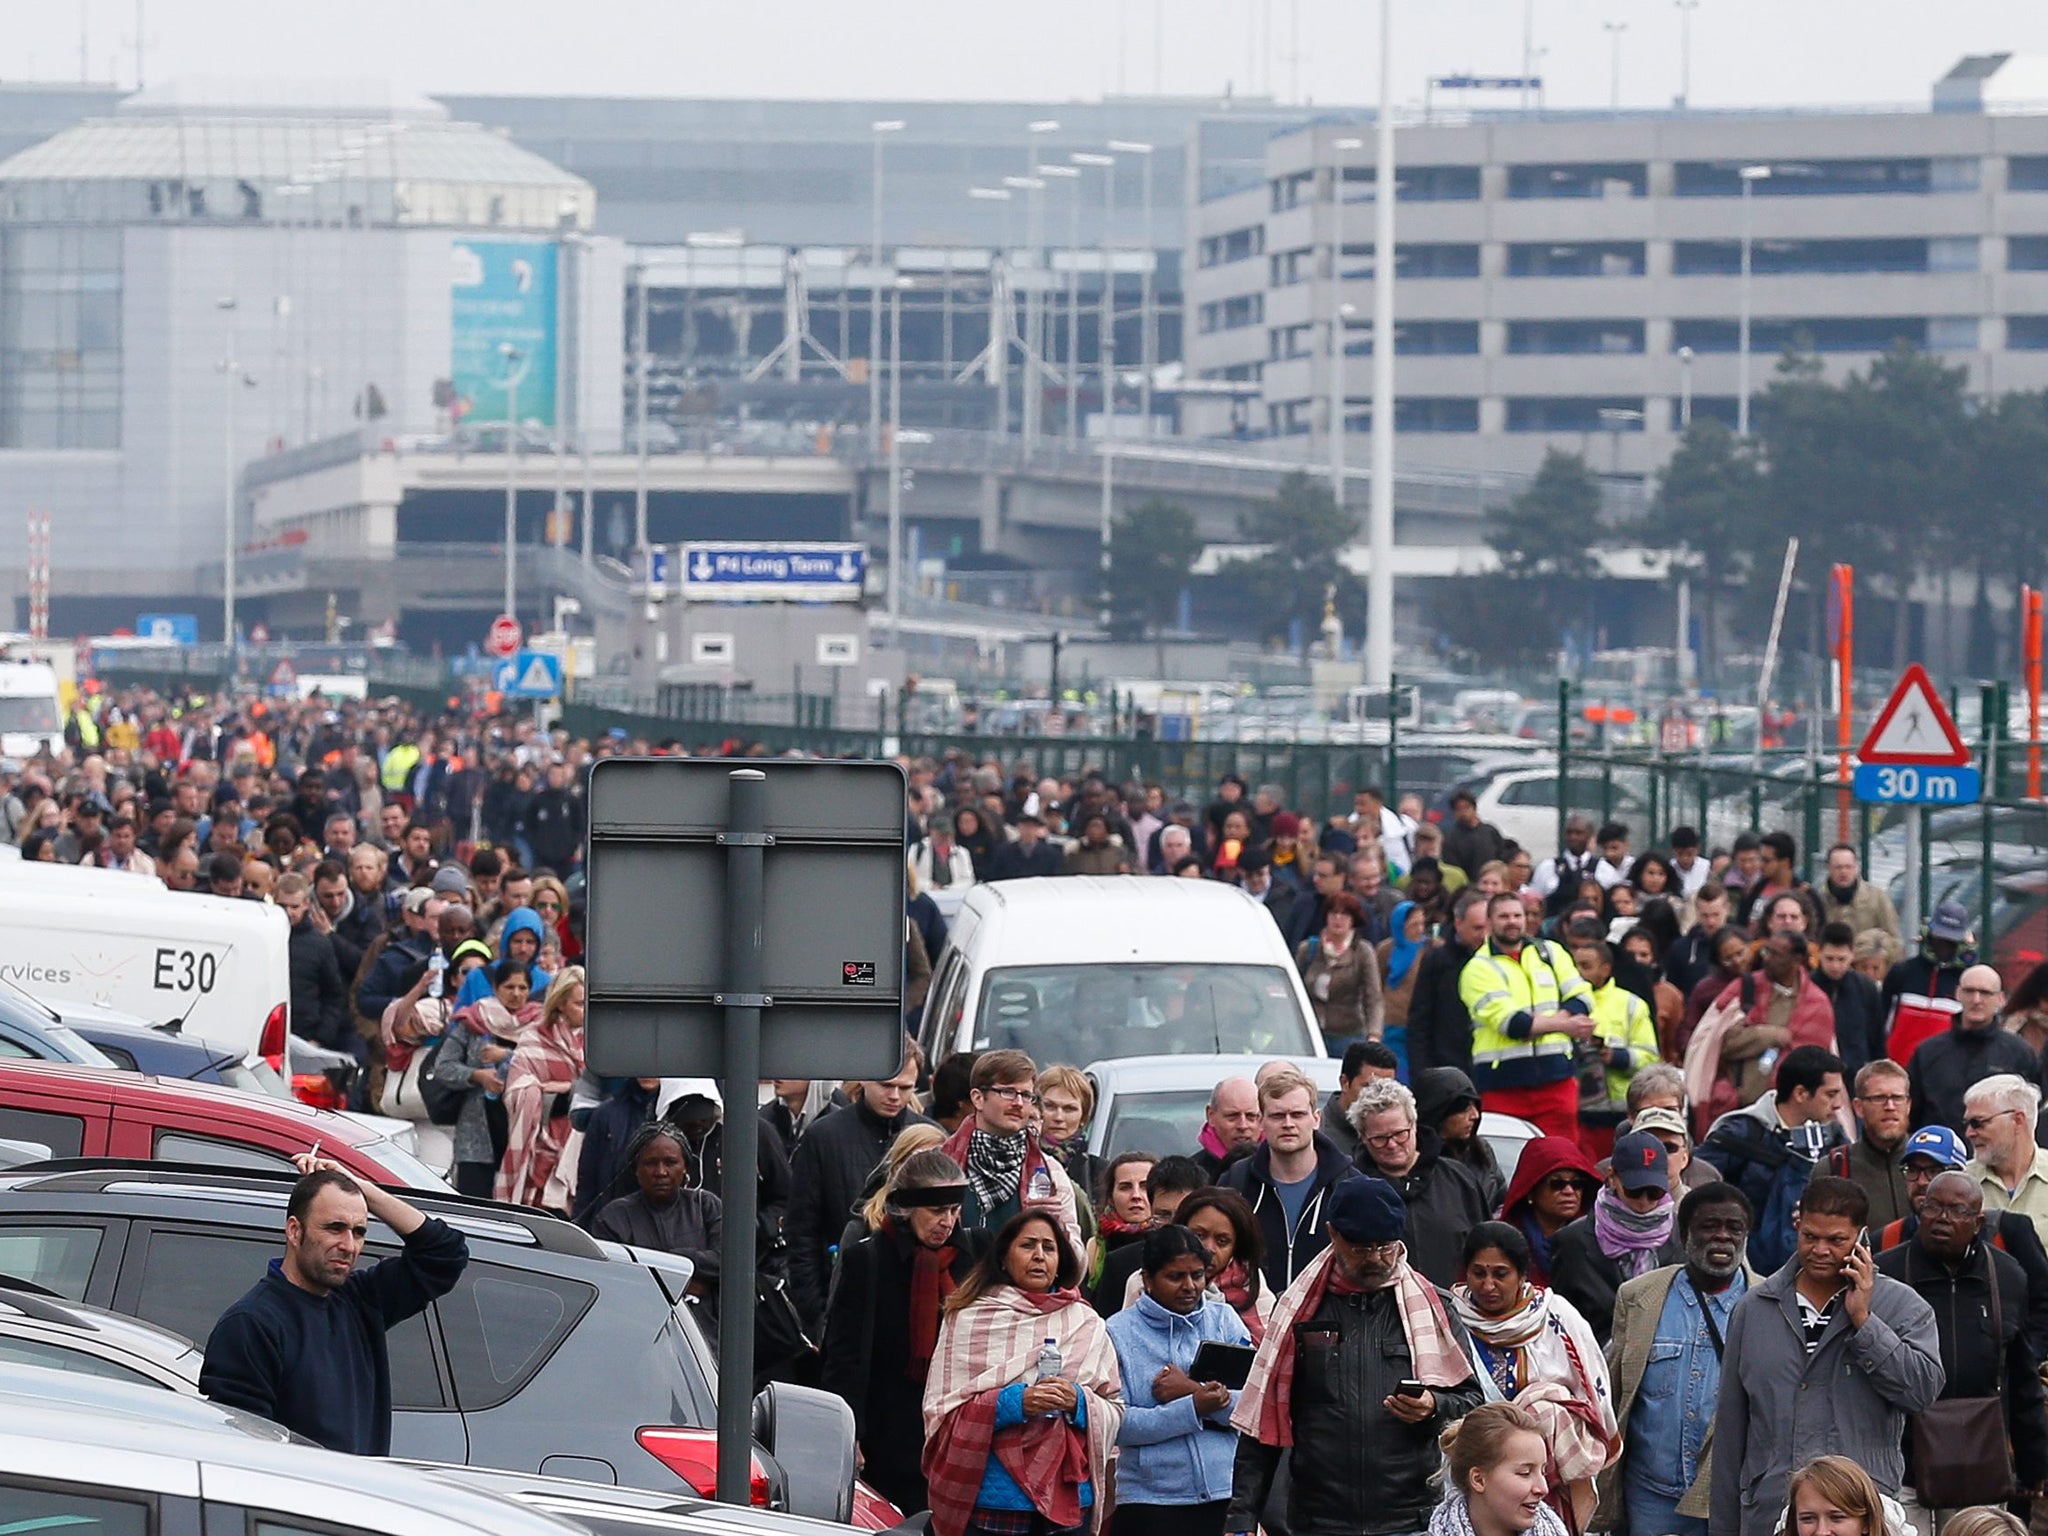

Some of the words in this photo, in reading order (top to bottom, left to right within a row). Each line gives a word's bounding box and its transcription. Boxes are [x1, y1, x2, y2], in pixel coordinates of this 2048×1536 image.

[742, 555, 788, 578] Long
[789, 555, 834, 574] Term
[1877, 767, 1920, 799] 30
[1925, 776, 1958, 799] m
[154, 948, 216, 993] E30
[1642, 1147, 1658, 1167] P
